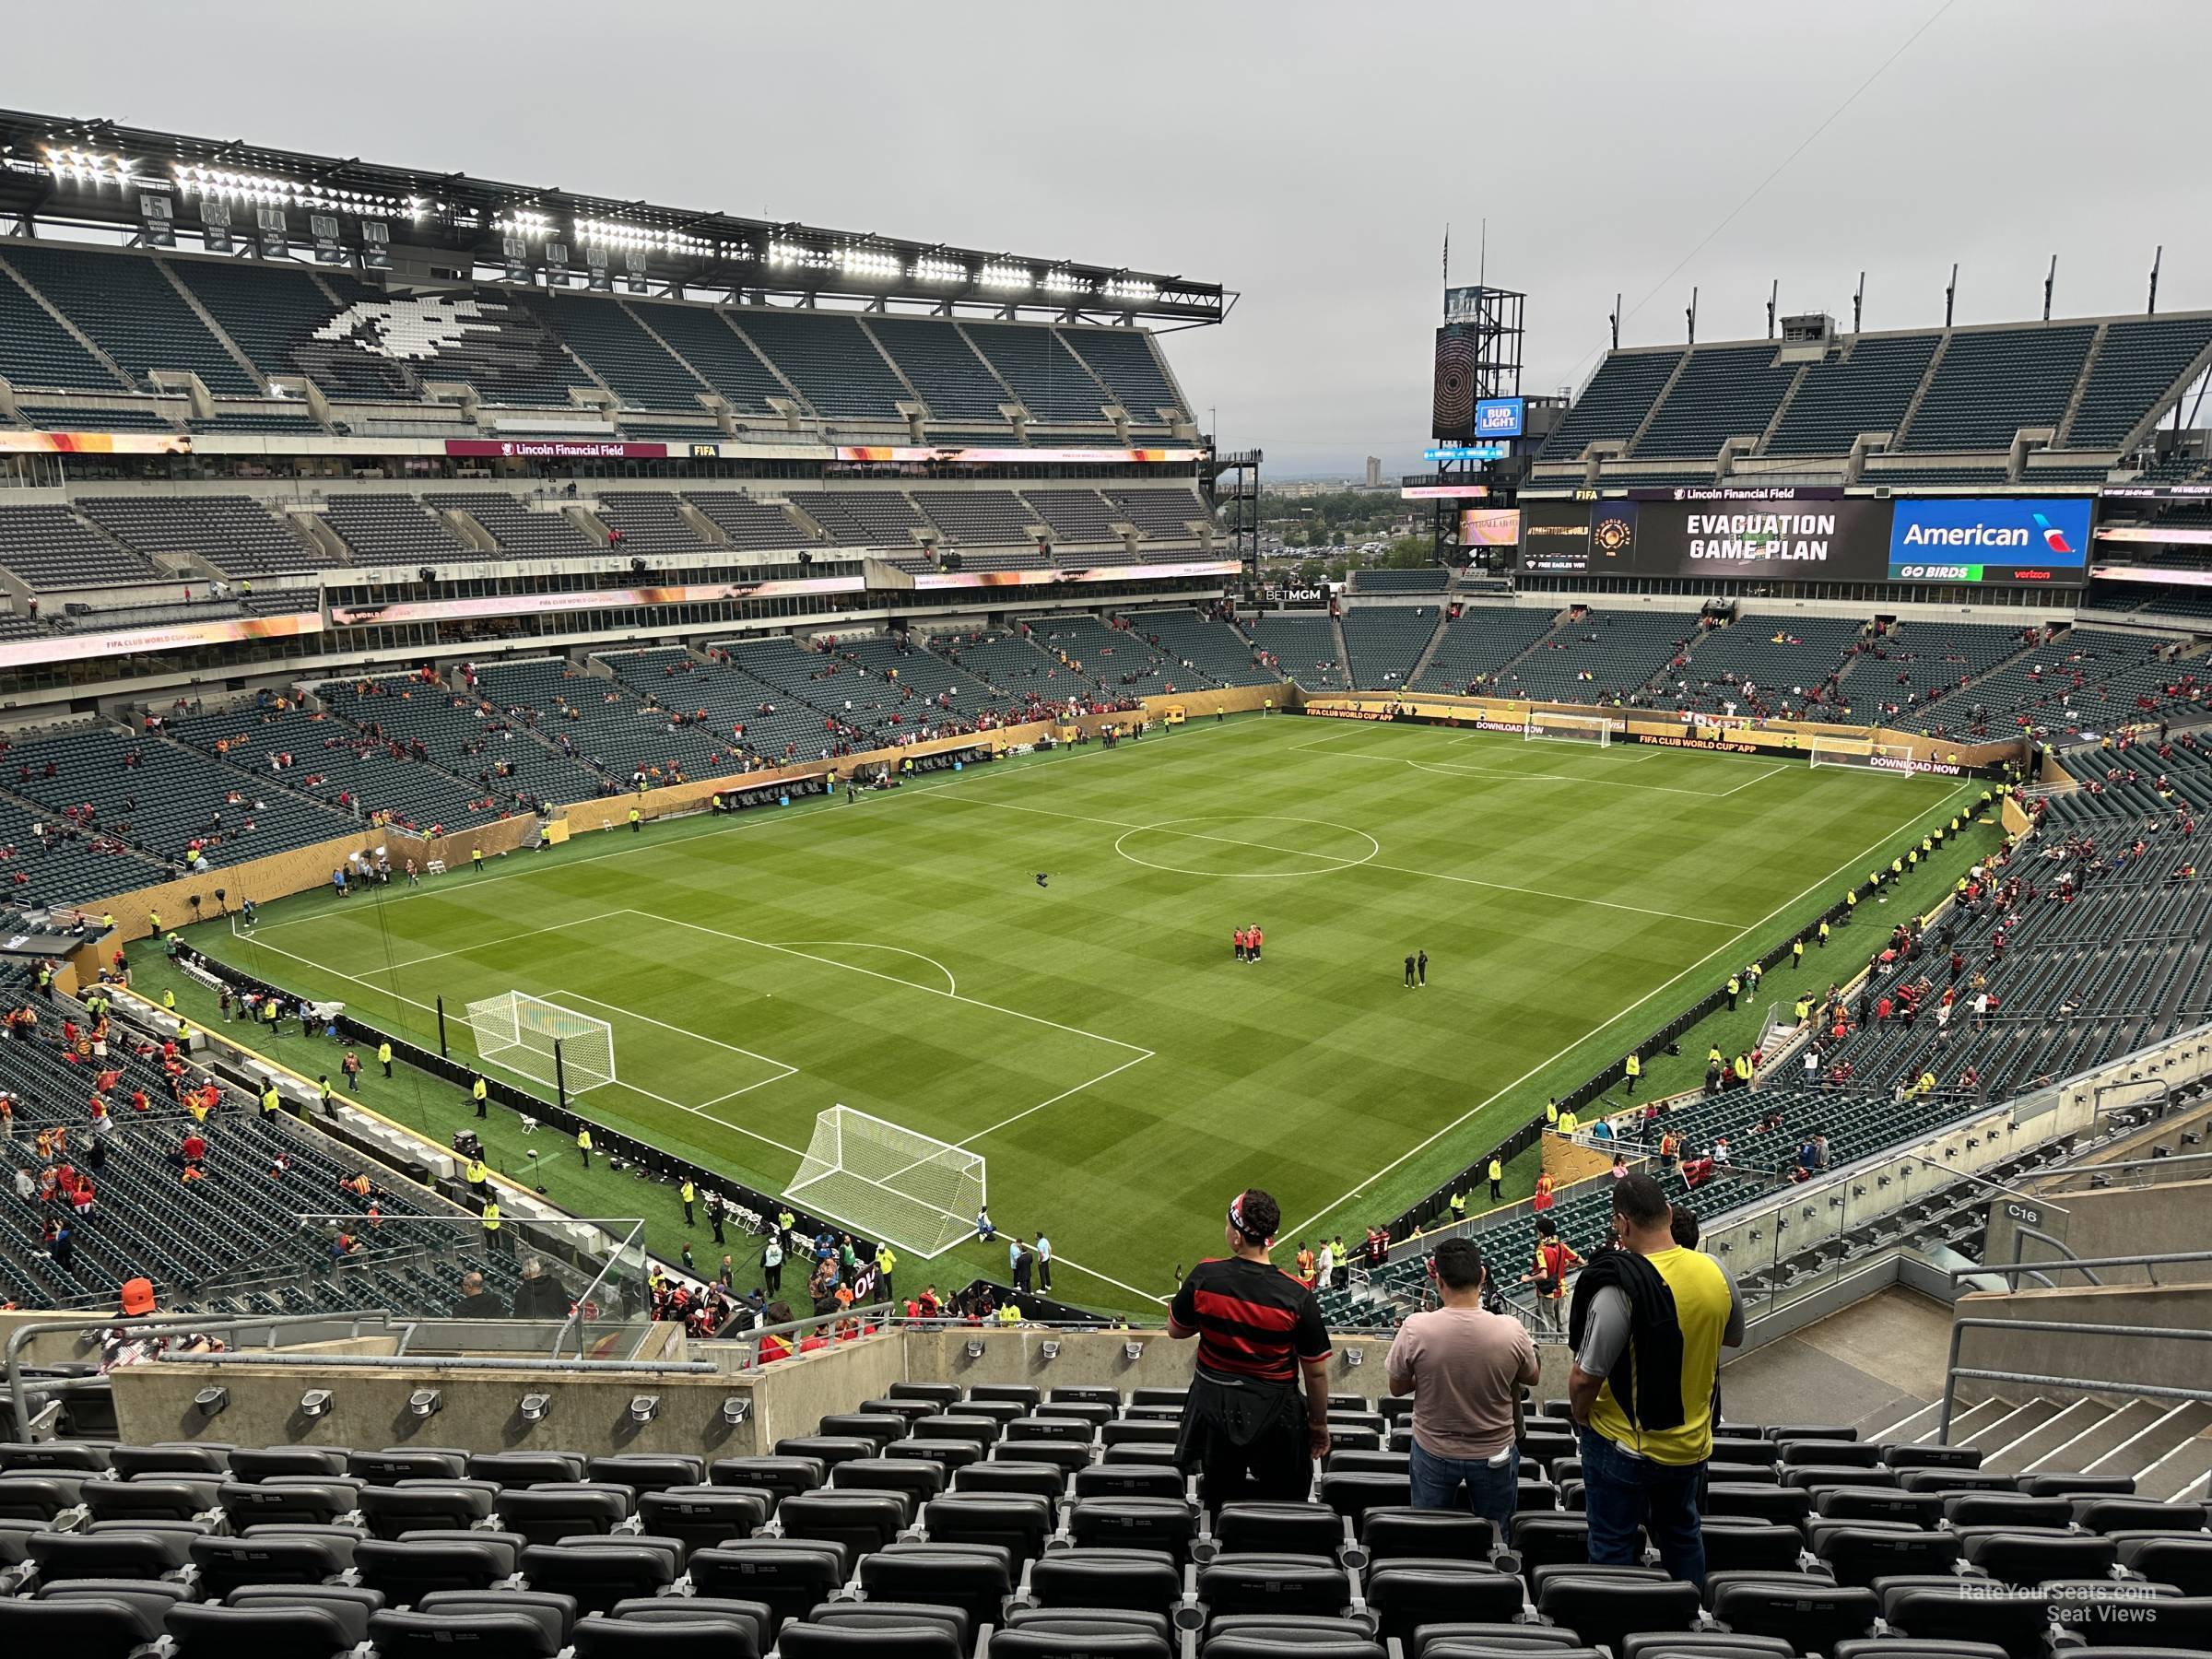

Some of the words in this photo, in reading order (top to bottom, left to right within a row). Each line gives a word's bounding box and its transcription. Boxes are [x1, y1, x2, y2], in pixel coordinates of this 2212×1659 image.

[150, 197, 164, 218] 5
[261, 210, 282, 232] 44
[313, 217, 337, 238] 60
[365, 221, 386, 243] 70
[506, 240, 524, 258] 15
[548, 245, 566, 264] 40
[1446, 315, 1478, 324] CHAMPIONS
[1487, 408, 1512, 418] BUD
[1482, 417, 1516, 429] LIGHT
[516, 444, 553, 456] Lincoln
[555, 444, 598, 456] Financial
[601, 445, 624, 456] Field
[694, 446, 716, 456] FIFA
[1576, 490, 1598, 500] FIFA
[1687, 488, 1723, 499] Lincoln
[1724, 488, 1769, 500] Financial
[1770, 488, 1794, 499] Field
[1688, 514, 1836, 535] EVACUATION
[1903, 524, 2028, 546] American
[1689, 540, 1757, 559] GAME
[1764, 541, 1828, 560] PLAN
[1552, 560, 1572, 569] EAGLES
[1900, 566, 1922, 577] GO
[1924, 566, 1969, 578] BIRDS
[2013, 571, 2051, 579] verizon
[1266, 590, 1321, 600] BETMGM
[106, 640, 123, 648] FIFA
[124, 638, 143, 646] CLUB
[144, 635, 170, 644] WORLD
[1306, 708, 1321, 716] FIFA
[1339, 711, 1363, 719] WORLD
[1477, 722, 1523, 732] DOWNLOAD
[1640, 735, 1657, 744] FIFA
[1659, 737, 1682, 747] CLUB
[1682, 740, 1715, 749] WORLD
[1738, 745, 1757, 753] APP
[1870, 758, 1932, 771] DOWNLOAD
[1933, 764, 1960, 774] NOW
[2009, 1205, 2037, 1222] C16
